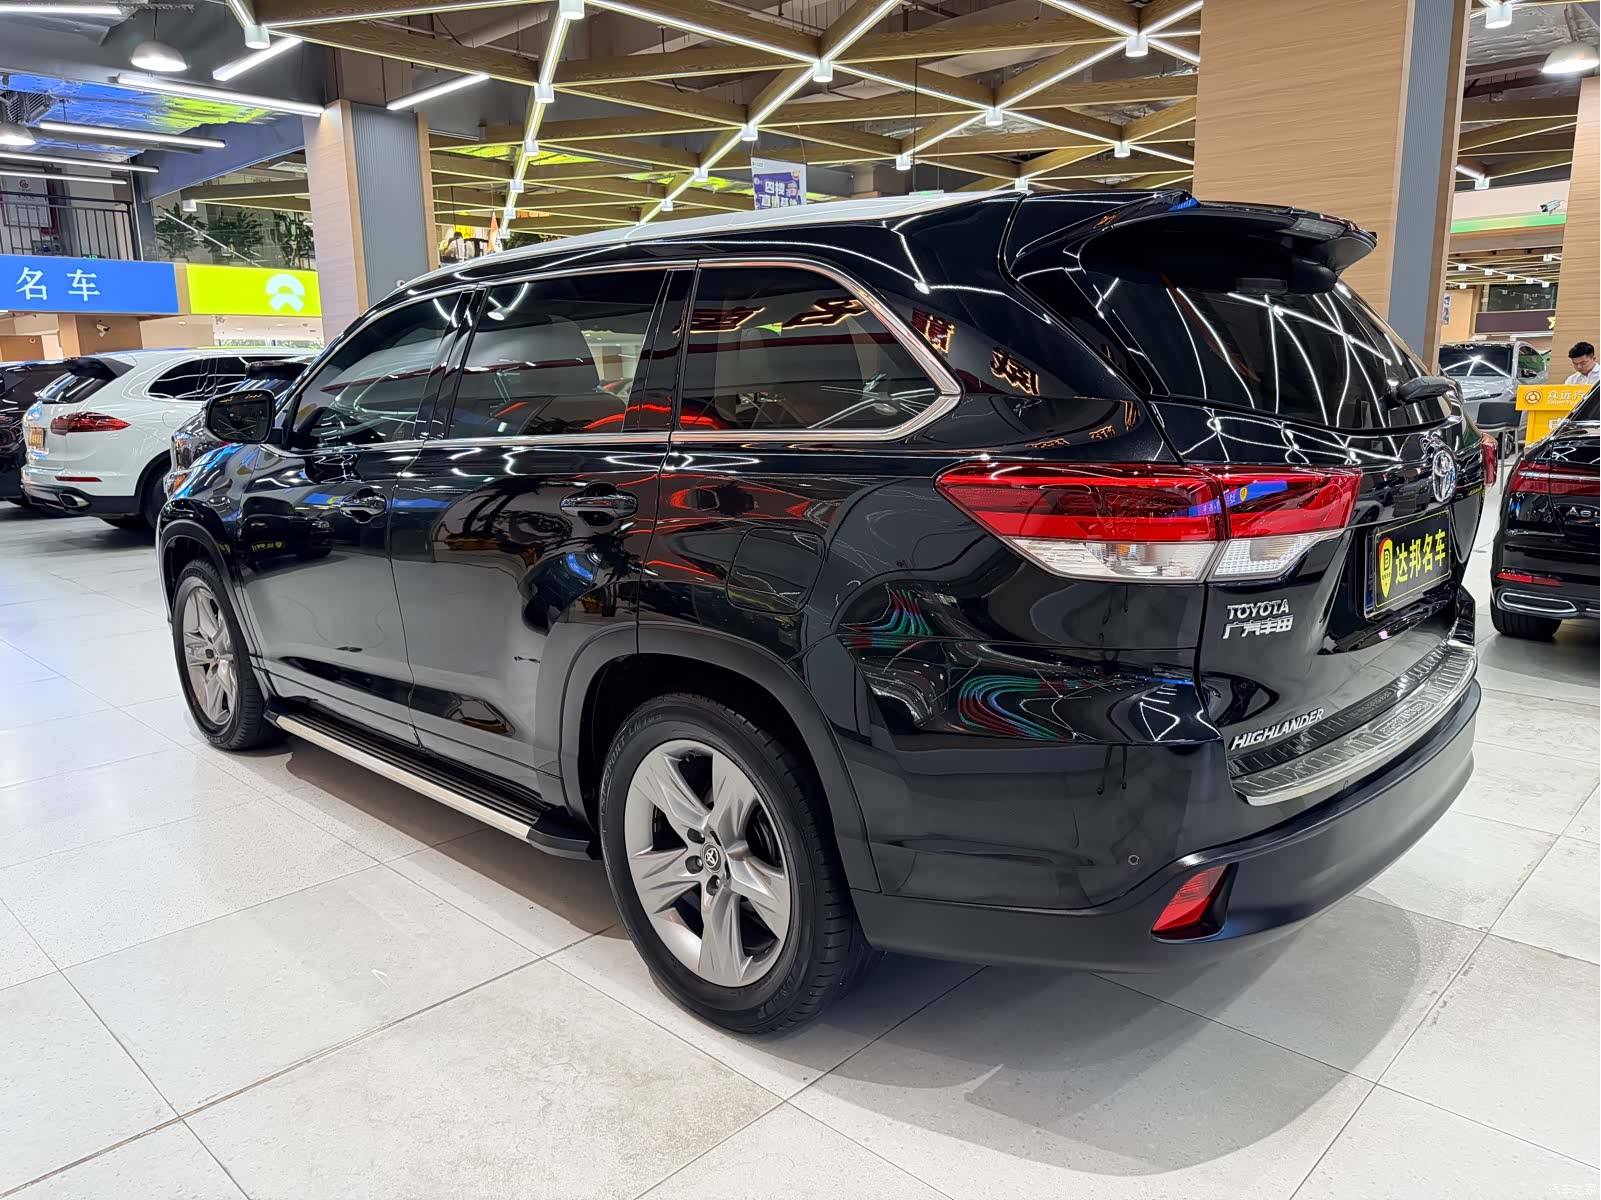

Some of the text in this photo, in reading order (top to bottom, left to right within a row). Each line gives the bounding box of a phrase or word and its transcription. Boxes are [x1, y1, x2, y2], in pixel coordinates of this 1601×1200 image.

[16, 266, 101, 302] 名车
[1395, 529, 1446, 585] 达邦名车
[1222, 615, 1294, 639] 广汽丰田
[1227, 599, 1289, 620] TOYOTA
[1230, 707, 1325, 750] HIGHLANDER
